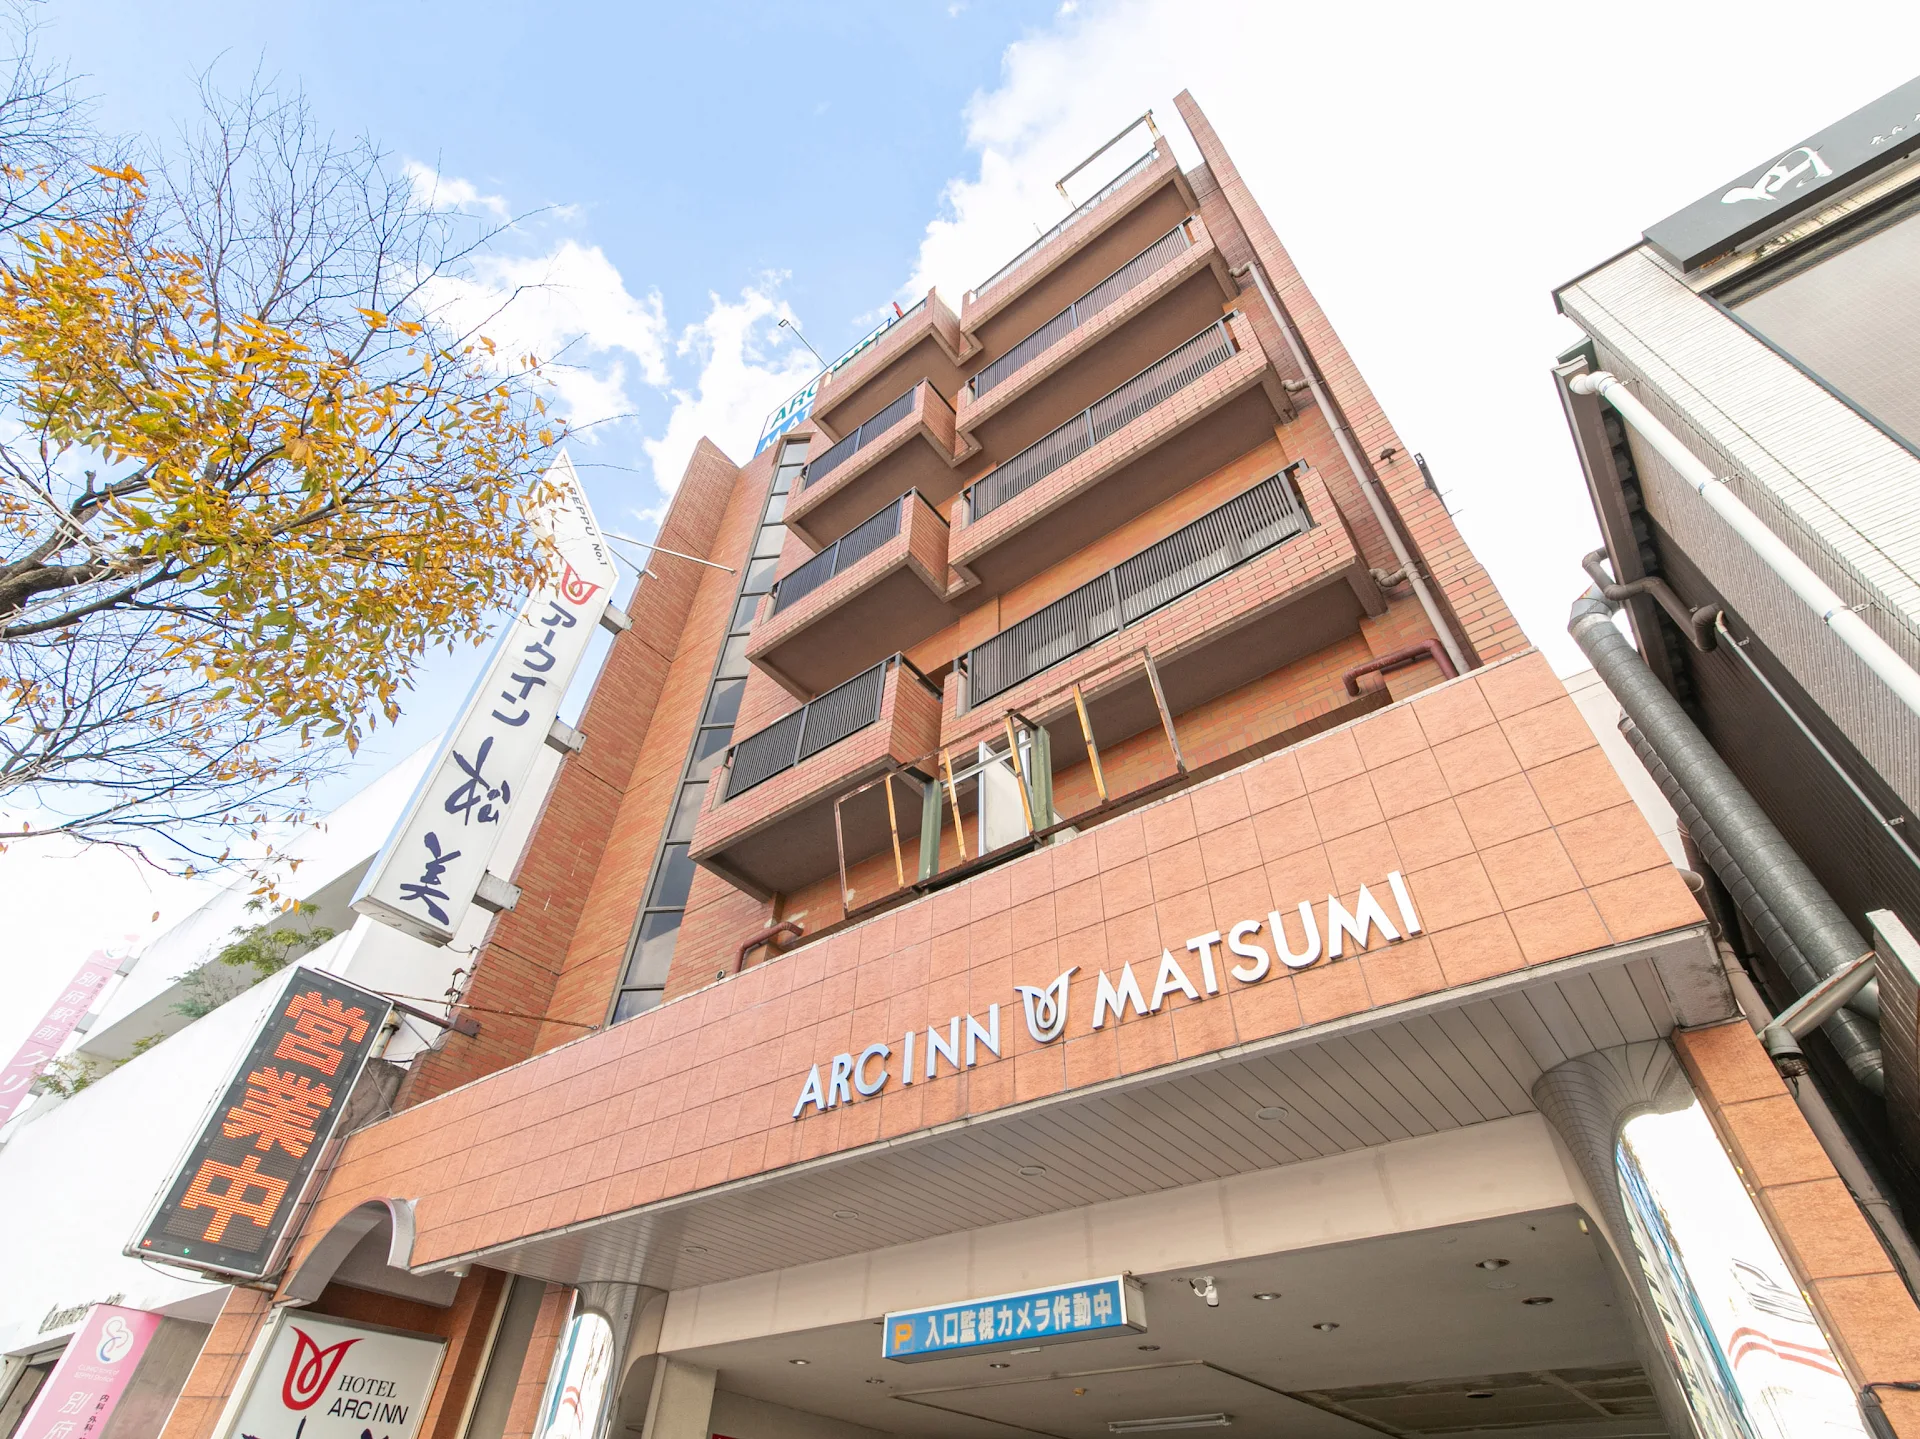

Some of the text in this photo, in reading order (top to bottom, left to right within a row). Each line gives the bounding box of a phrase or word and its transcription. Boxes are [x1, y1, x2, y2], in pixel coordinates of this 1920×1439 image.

[770, 378, 820, 430] ARC
[568, 486, 608, 566] BEPPU No.1
[400, 601, 577, 926] アークイン 松美
[792, 870, 1423, 1119] ARC INN MATSUMI
[181, 991, 371, 1243] 営業中
[894, 1289, 1112, 1350] P 入口監視カメラ作動中
[78, 1394, 110, 1439] 内科・外科・
[337, 1375, 398, 1399] HOTEL
